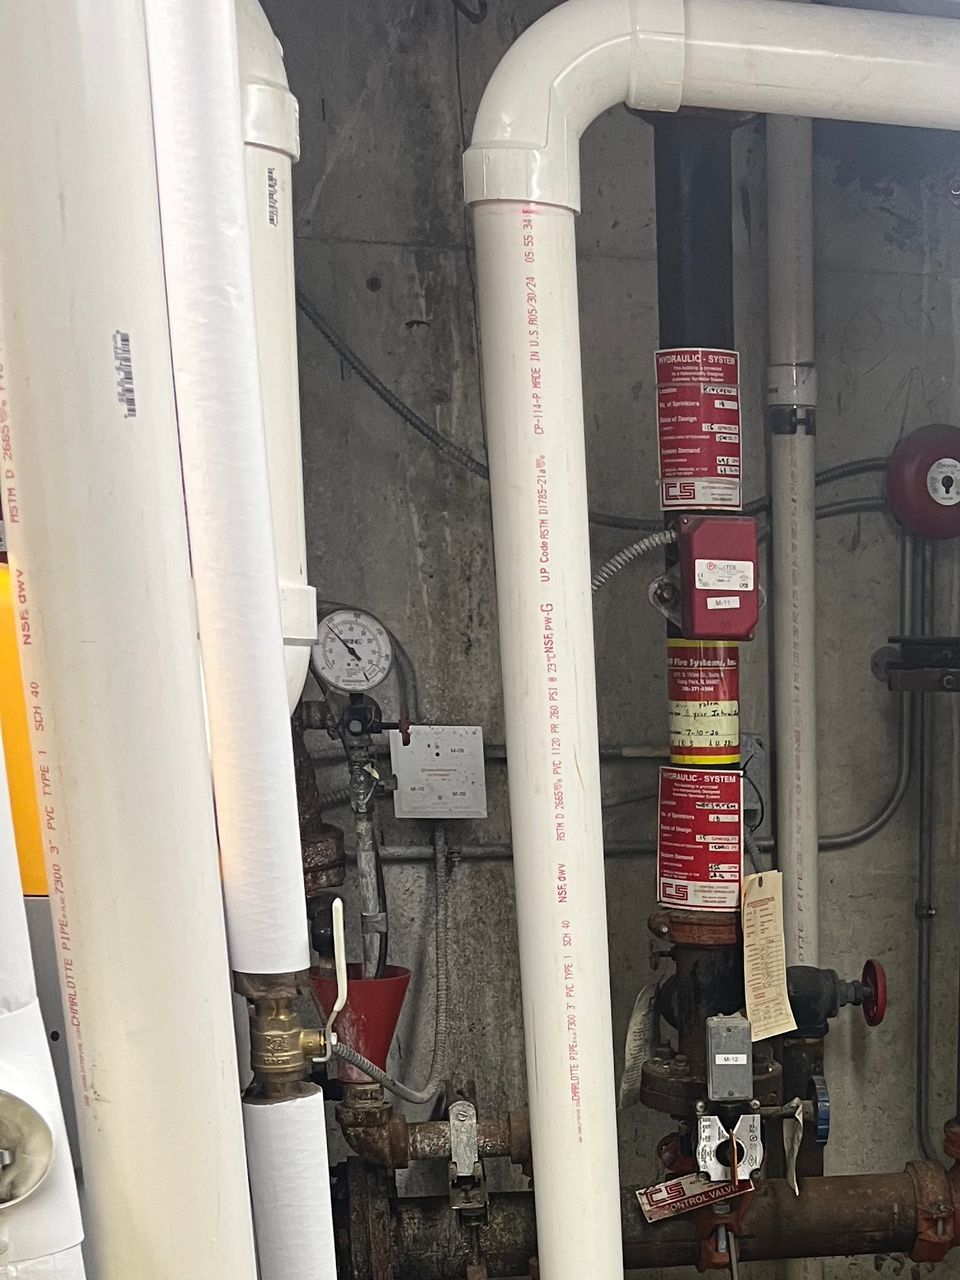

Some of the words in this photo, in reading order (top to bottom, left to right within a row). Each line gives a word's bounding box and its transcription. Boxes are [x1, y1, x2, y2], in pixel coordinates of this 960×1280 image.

[659, 355, 701, 364] HYDRAULIC
[531, 368, 540, 389] MADE
[540, 519, 548, 541] ASTM
[674, 658, 688, 666] Fire
[704, 775, 736, 783] SYSTEM
